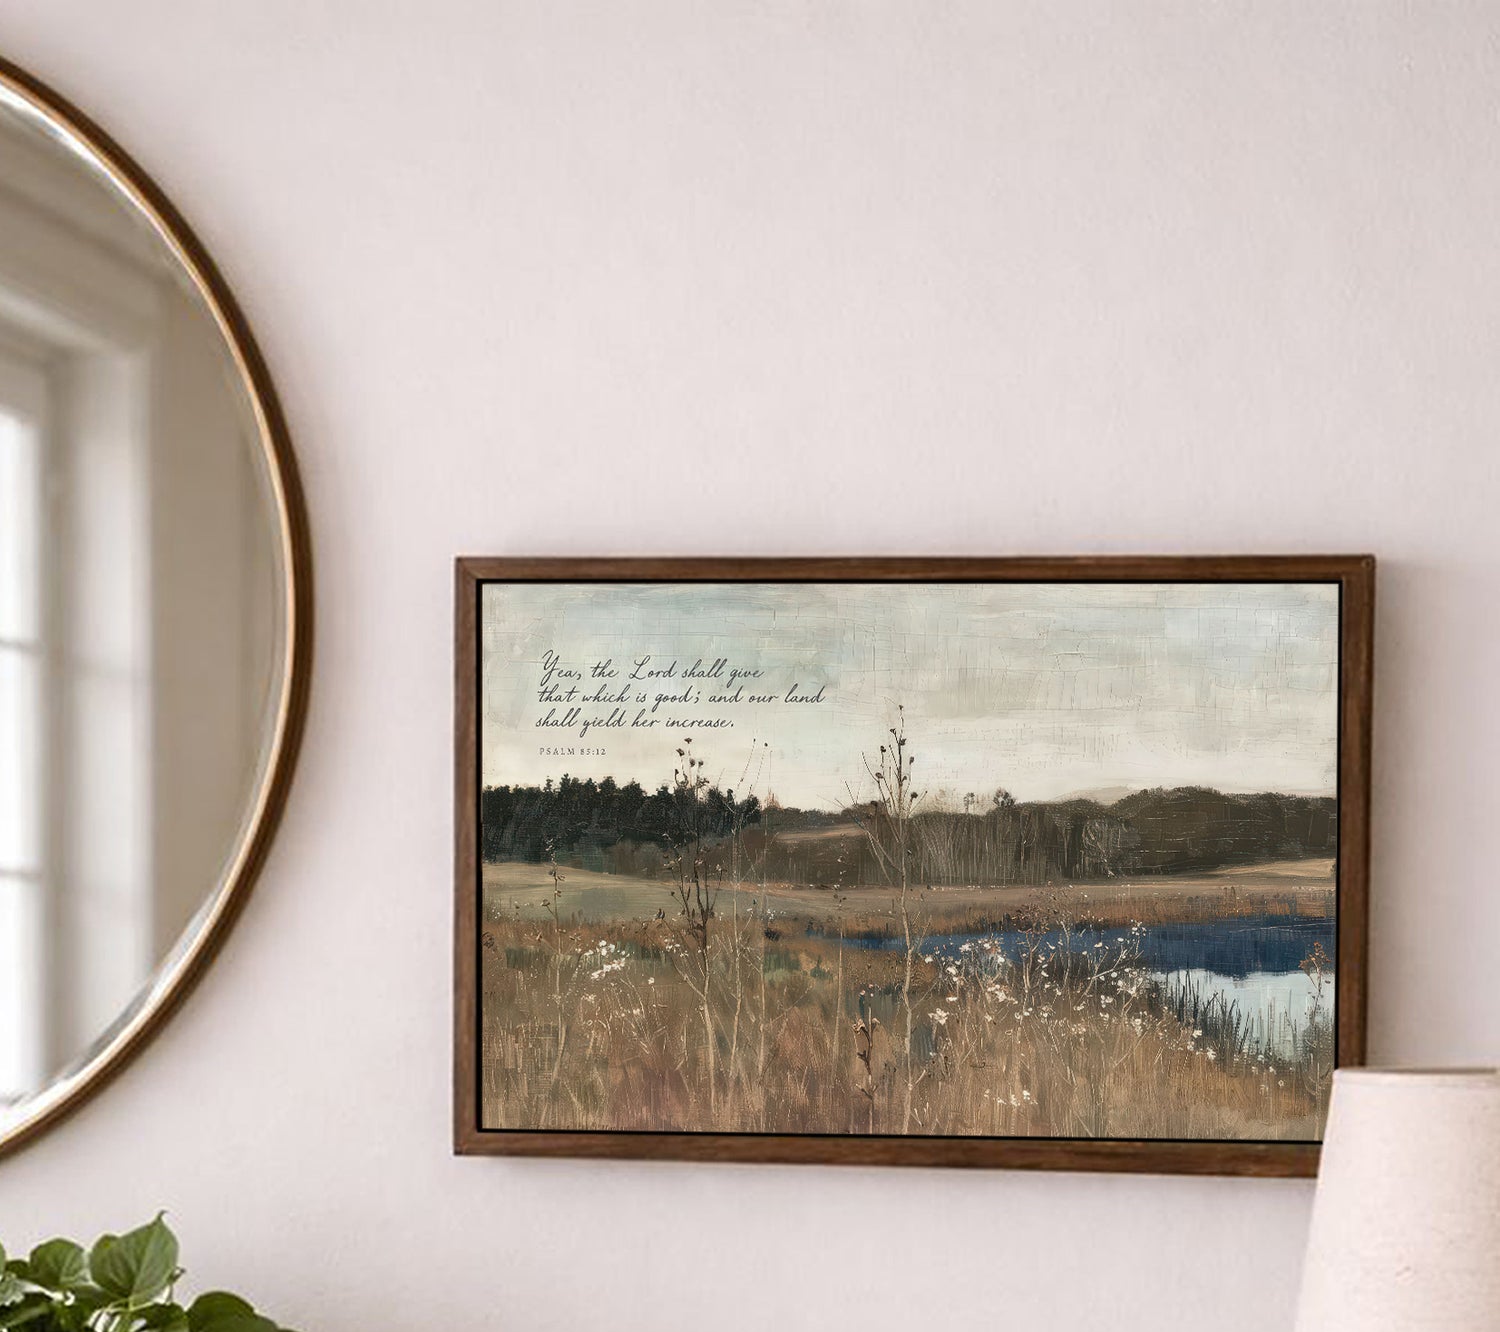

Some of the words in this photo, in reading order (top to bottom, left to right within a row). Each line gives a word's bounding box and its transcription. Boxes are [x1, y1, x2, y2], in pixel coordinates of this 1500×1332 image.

[540, 649, 582, 687] Yea,
[590, 658, 620, 678] the
[628, 655, 678, 680] Lord
[681, 658, 725, 679] shall
[726, 667, 765, 689] give
[537, 683, 581, 703] that
[581, 683, 631, 703] which
[635, 692, 647, 703] is
[651, 685, 701, 713] good;
[708, 685, 744, 703] and
[748, 695, 779, 704] our
[784, 683, 826, 704] land
[535, 707, 582, 728] shall
[579, 707, 627, 738] yield
[631, 708, 661, 728] her
[665, 717, 735, 728] increase.
[539, 748, 575, 756] PSALM
[580, 748, 607, 756] 85:12
